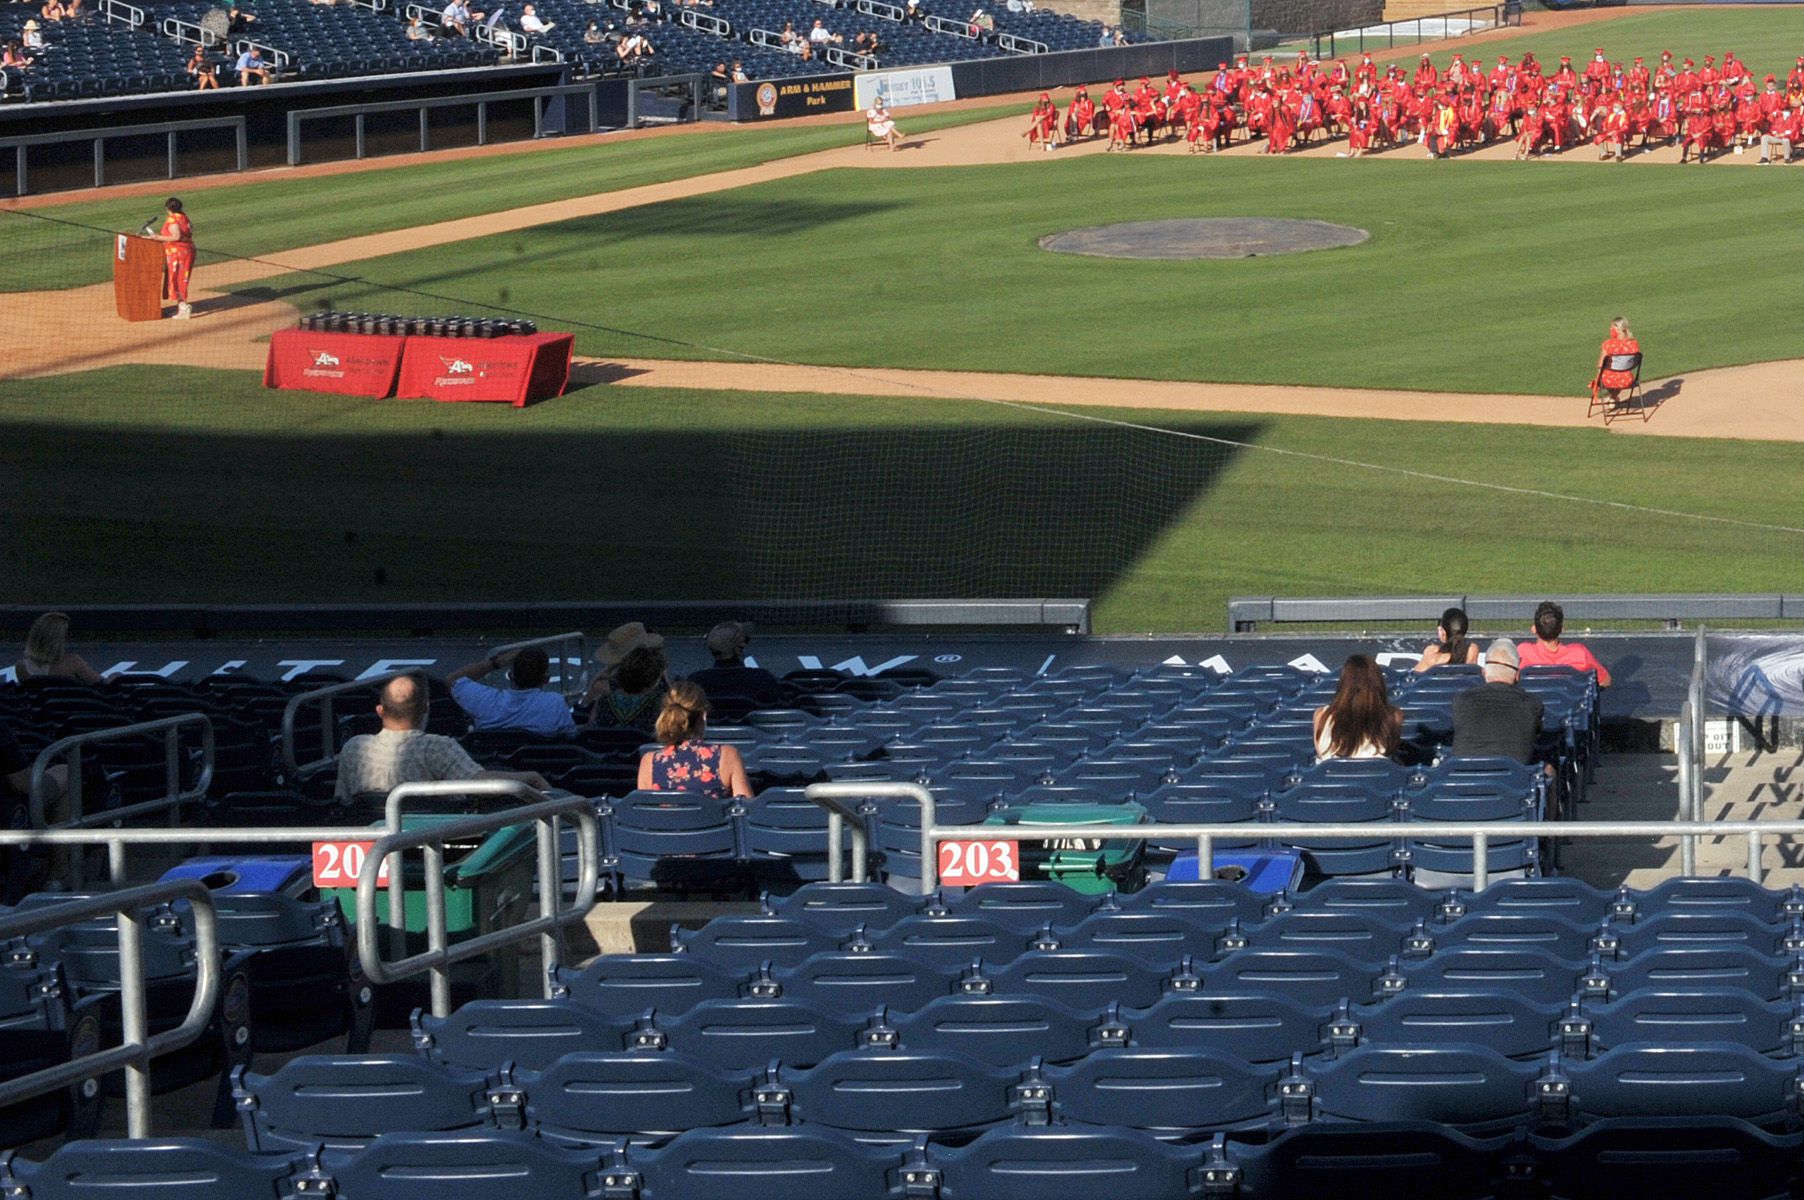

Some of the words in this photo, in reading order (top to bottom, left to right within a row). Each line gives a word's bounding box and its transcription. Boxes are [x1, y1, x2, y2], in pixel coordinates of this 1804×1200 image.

[780, 84, 801, 96] ARM
[803, 83, 810, 92] &
[812, 80, 851, 92] HAMMER
[806, 95, 826, 106] Park
[941, 841, 1016, 879] 203
